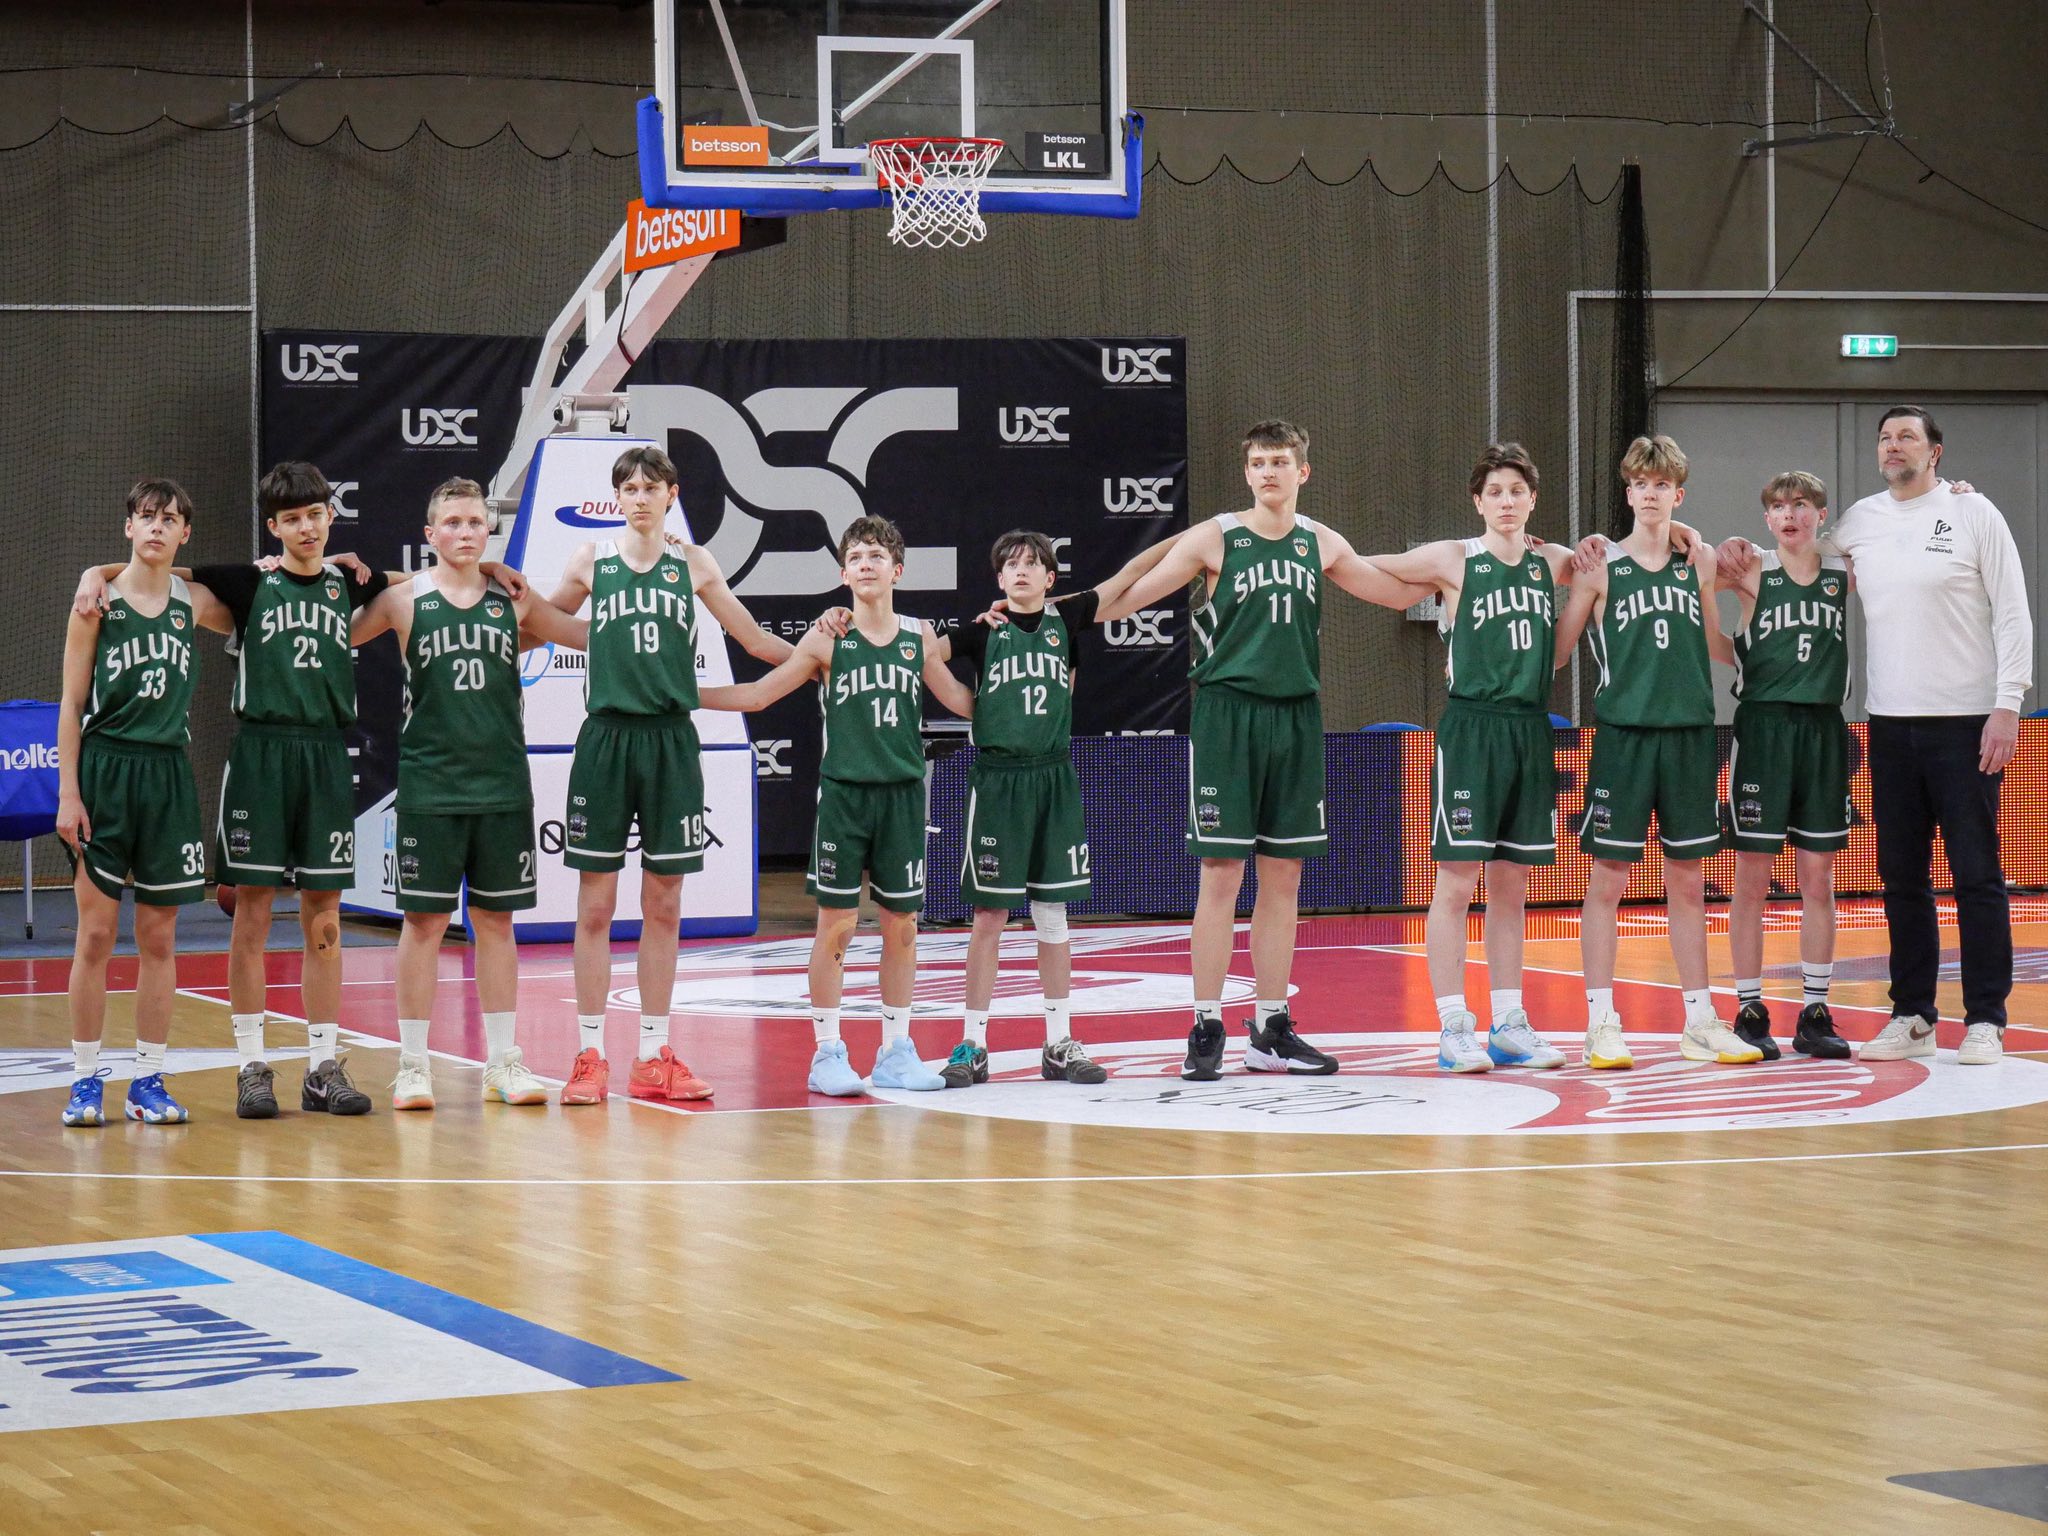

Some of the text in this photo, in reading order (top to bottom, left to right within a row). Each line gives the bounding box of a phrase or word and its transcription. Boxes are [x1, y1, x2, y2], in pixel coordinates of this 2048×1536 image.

[692, 139, 760, 152] betsson
[1044, 135, 1085, 143] betsson
[1044, 152, 1085, 168] LKL
[636, 209, 725, 258] betsson
[282, 344, 358, 381] UDSC
[1102, 348, 1171, 382] UDSC
[402, 409, 477, 444] UDSC
[999, 407, 1069, 442] UDSC
[1104, 478, 1173, 512] UDSC
[1234, 560, 1315, 604] ŠILUTĖ
[596, 587, 688, 632] ŠILUTĖ
[1269, 593, 1291, 623] 11
[1473, 587, 1551, 630] ŠILUTĖ
[1615, 586, 1700, 632] ŠILUTĖ
[1759, 601, 1843, 641] ŠILUTĖ
[261, 601, 347, 650] ŠILUTĖ
[631, 622, 659, 653] 19
[1104, 611, 1173, 645] UDSC
[1508, 619, 1532, 649] 10
[1655, 619, 1668, 649] 9
[106, 633, 190, 682] ŠILUTĖ
[294, 636, 322, 668] 23
[418, 623, 513, 669] ŠILUTĖ
[1798, 634, 1811, 662] 5
[138, 668, 166, 699] 33
[453, 659, 485, 690] 20
[836, 664, 920, 705] ŠILUTĖ
[988, 652, 1068, 693] ŠILUTĖ
[872, 698, 898, 727] 14
[1022, 685, 1047, 714] 12
[0, 744, 59, 770] olte
[330, 831, 353, 863] 23
[681, 815, 703, 847] 19
[182, 842, 204, 875] 33
[905, 859, 923, 888] 14
[1067, 843, 1089, 875] 12
